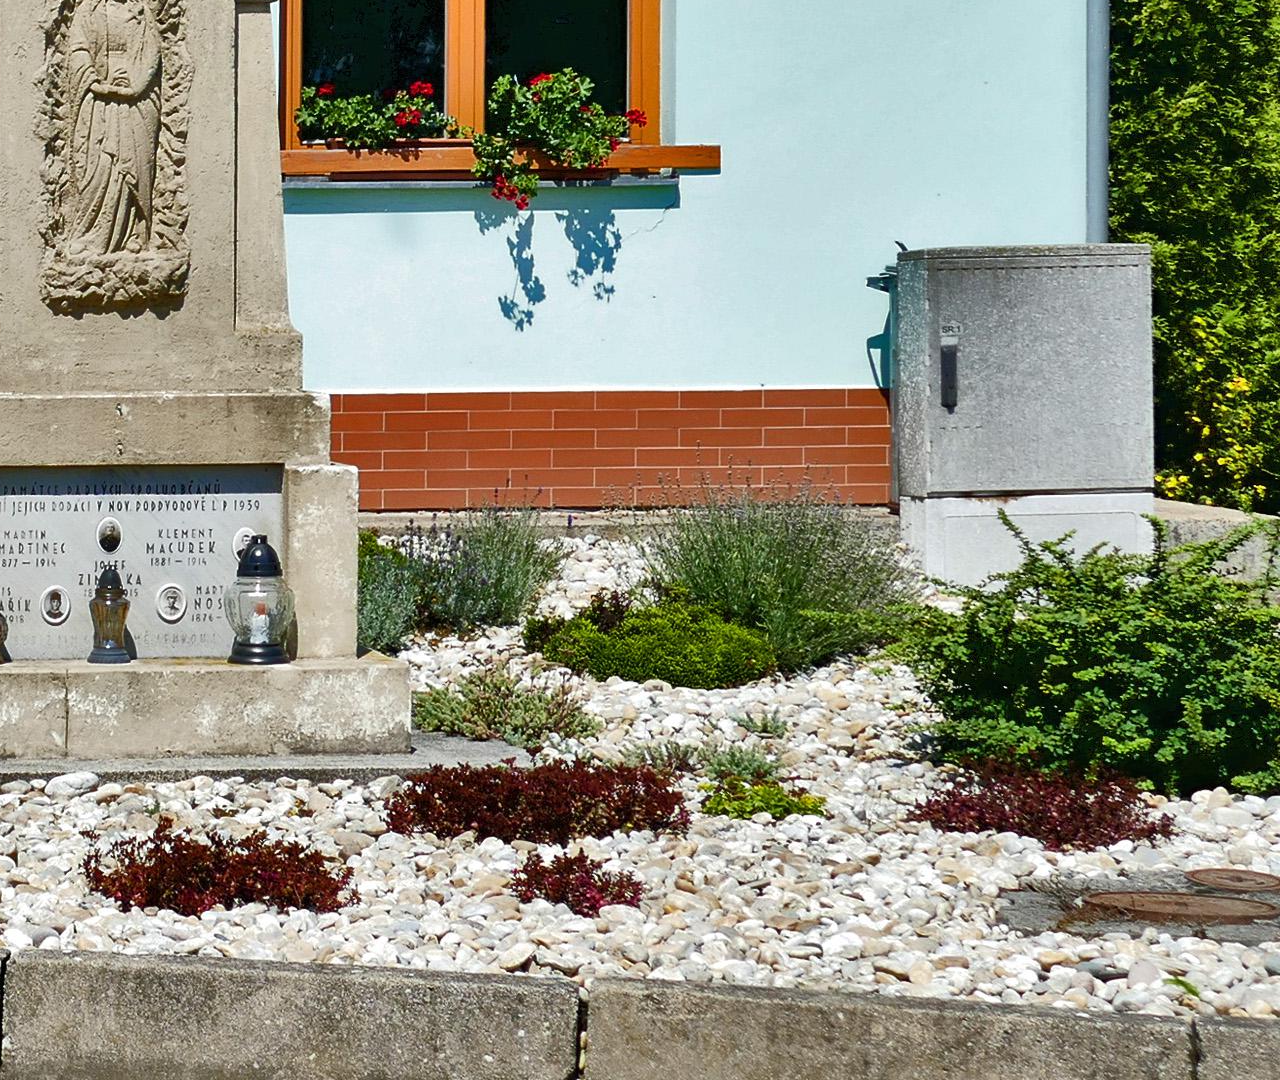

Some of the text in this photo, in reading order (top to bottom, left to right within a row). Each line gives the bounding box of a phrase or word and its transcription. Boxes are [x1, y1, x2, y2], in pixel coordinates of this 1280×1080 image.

[3, 481, 59, 496] PAMÁTCE
[12, 501, 46, 516] JEJICH
[233, 499, 260, 511] 1939
[3, 529, 47, 540] MARTIN
[158, 528, 214, 539] KLEMENT
[146, 541, 216, 554] MACUREK
[36, 558, 57, 568] 1914
[187, 557, 207, 567] 1914
